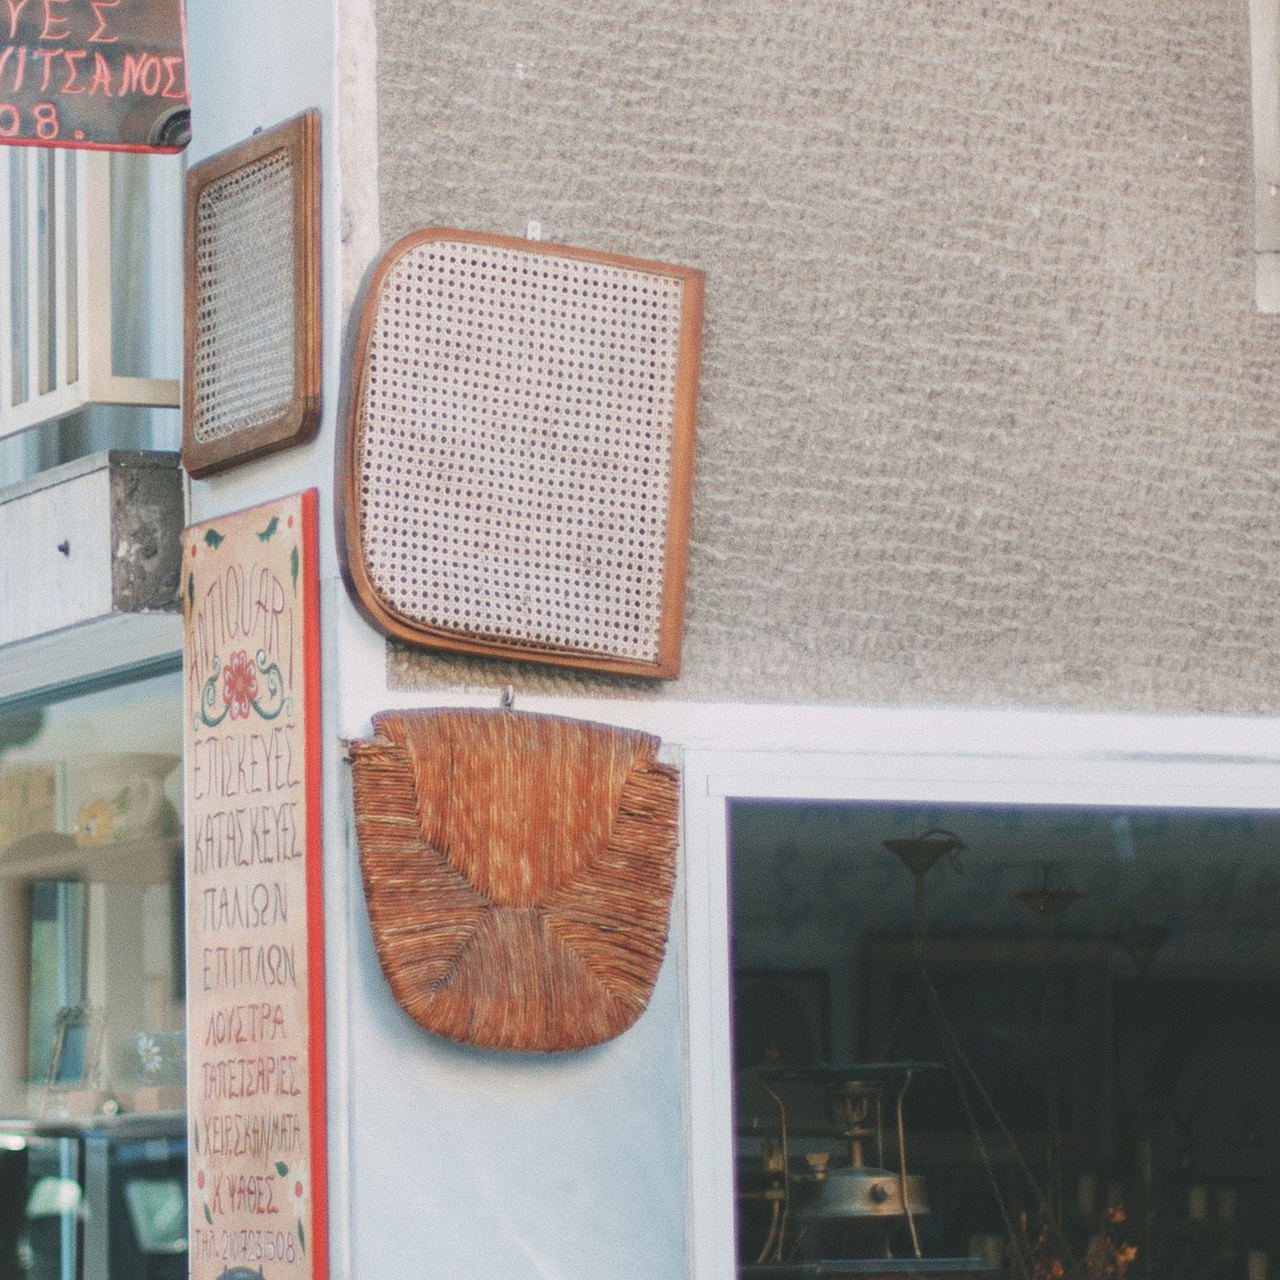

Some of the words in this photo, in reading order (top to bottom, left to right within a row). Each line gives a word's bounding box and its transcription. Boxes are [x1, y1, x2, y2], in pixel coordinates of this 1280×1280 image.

[193, 723, 301, 800] ΕΠΙΣΚΕΥΕΣ
[194, 802, 303, 874] ΚΑΤΑΣΚΕΥΕΣ
[203, 944, 297, 992] ΕΠΙΠΛΩΝ
